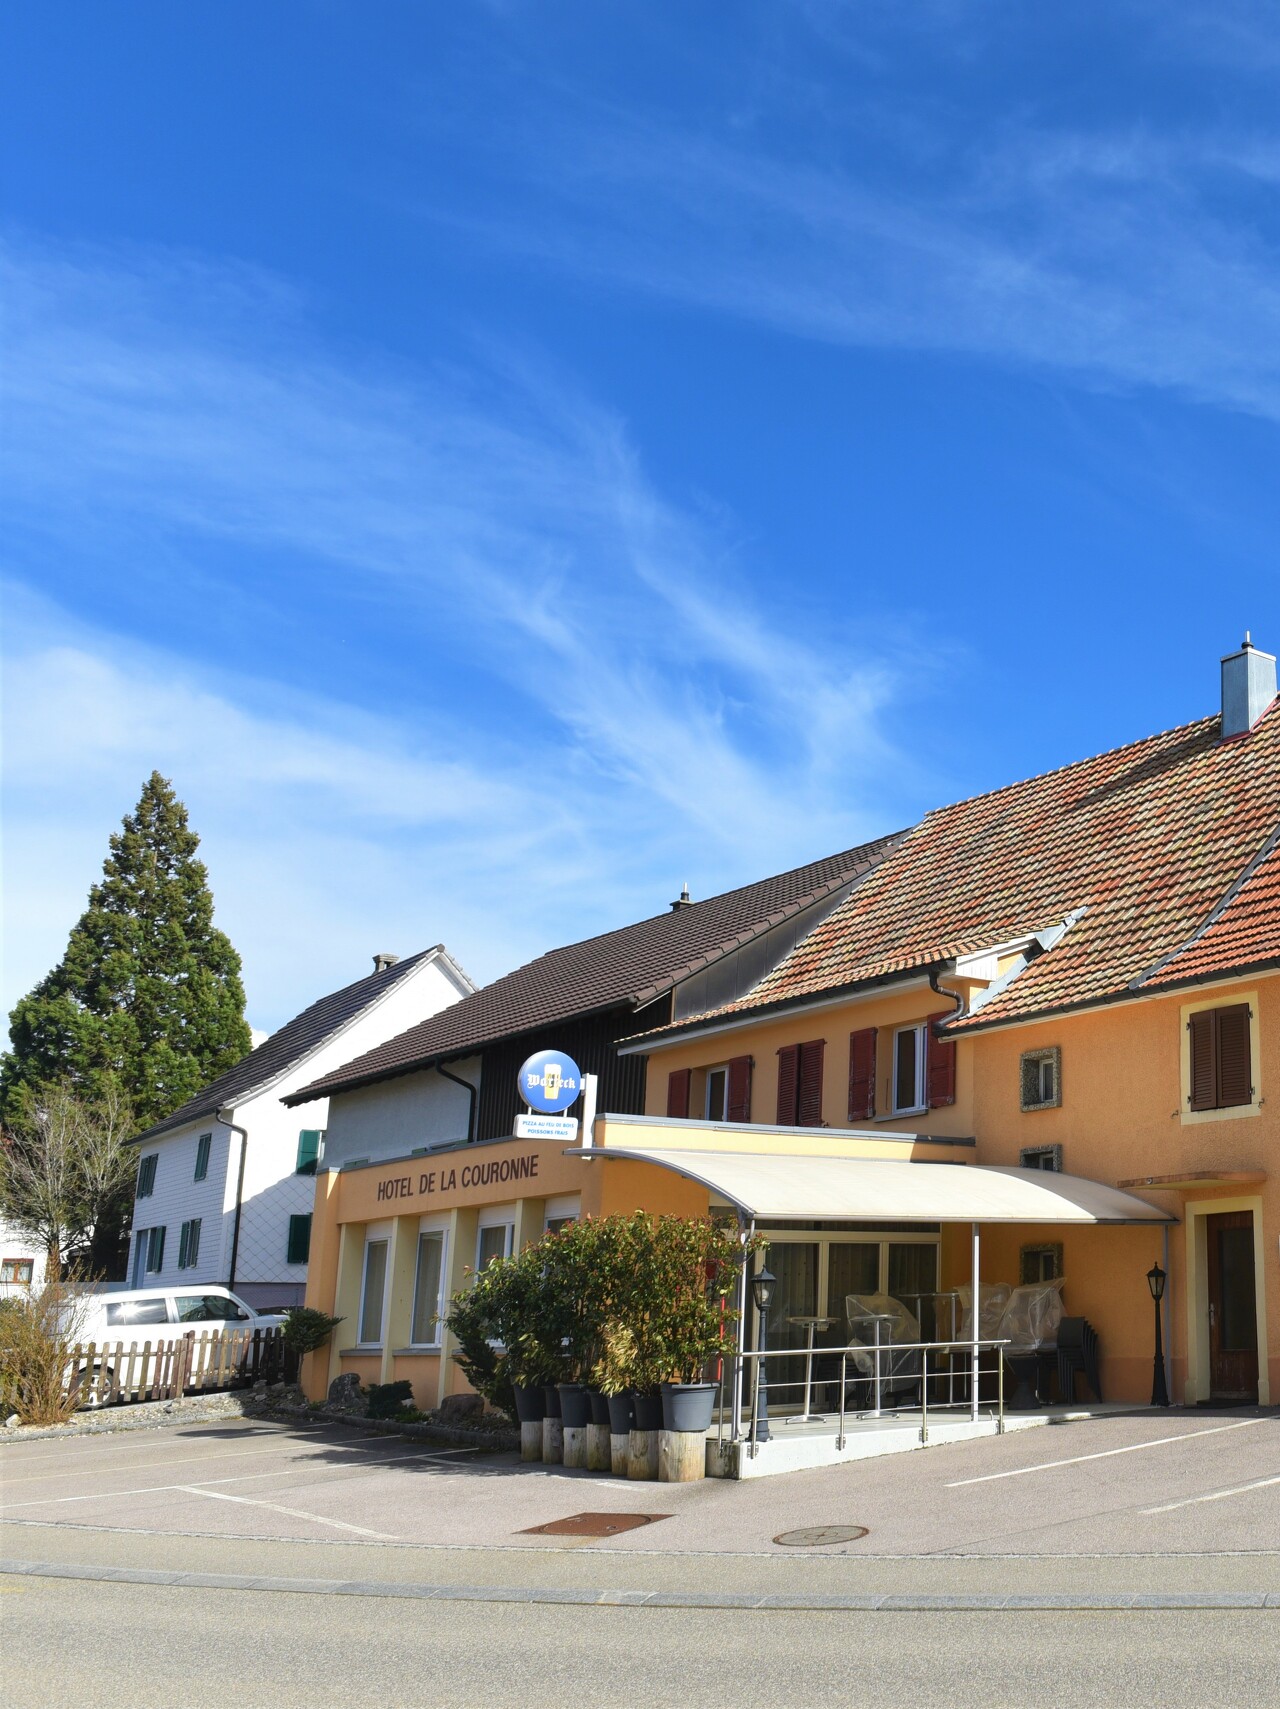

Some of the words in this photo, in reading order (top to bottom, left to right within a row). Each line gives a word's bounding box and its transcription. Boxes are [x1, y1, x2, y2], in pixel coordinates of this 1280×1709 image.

[378, 1177, 413, 1201] HOTEL
[419, 1172, 435, 1194] DE
[441, 1169, 457, 1191] LA
[461, 1155, 539, 1188] COURONNE
